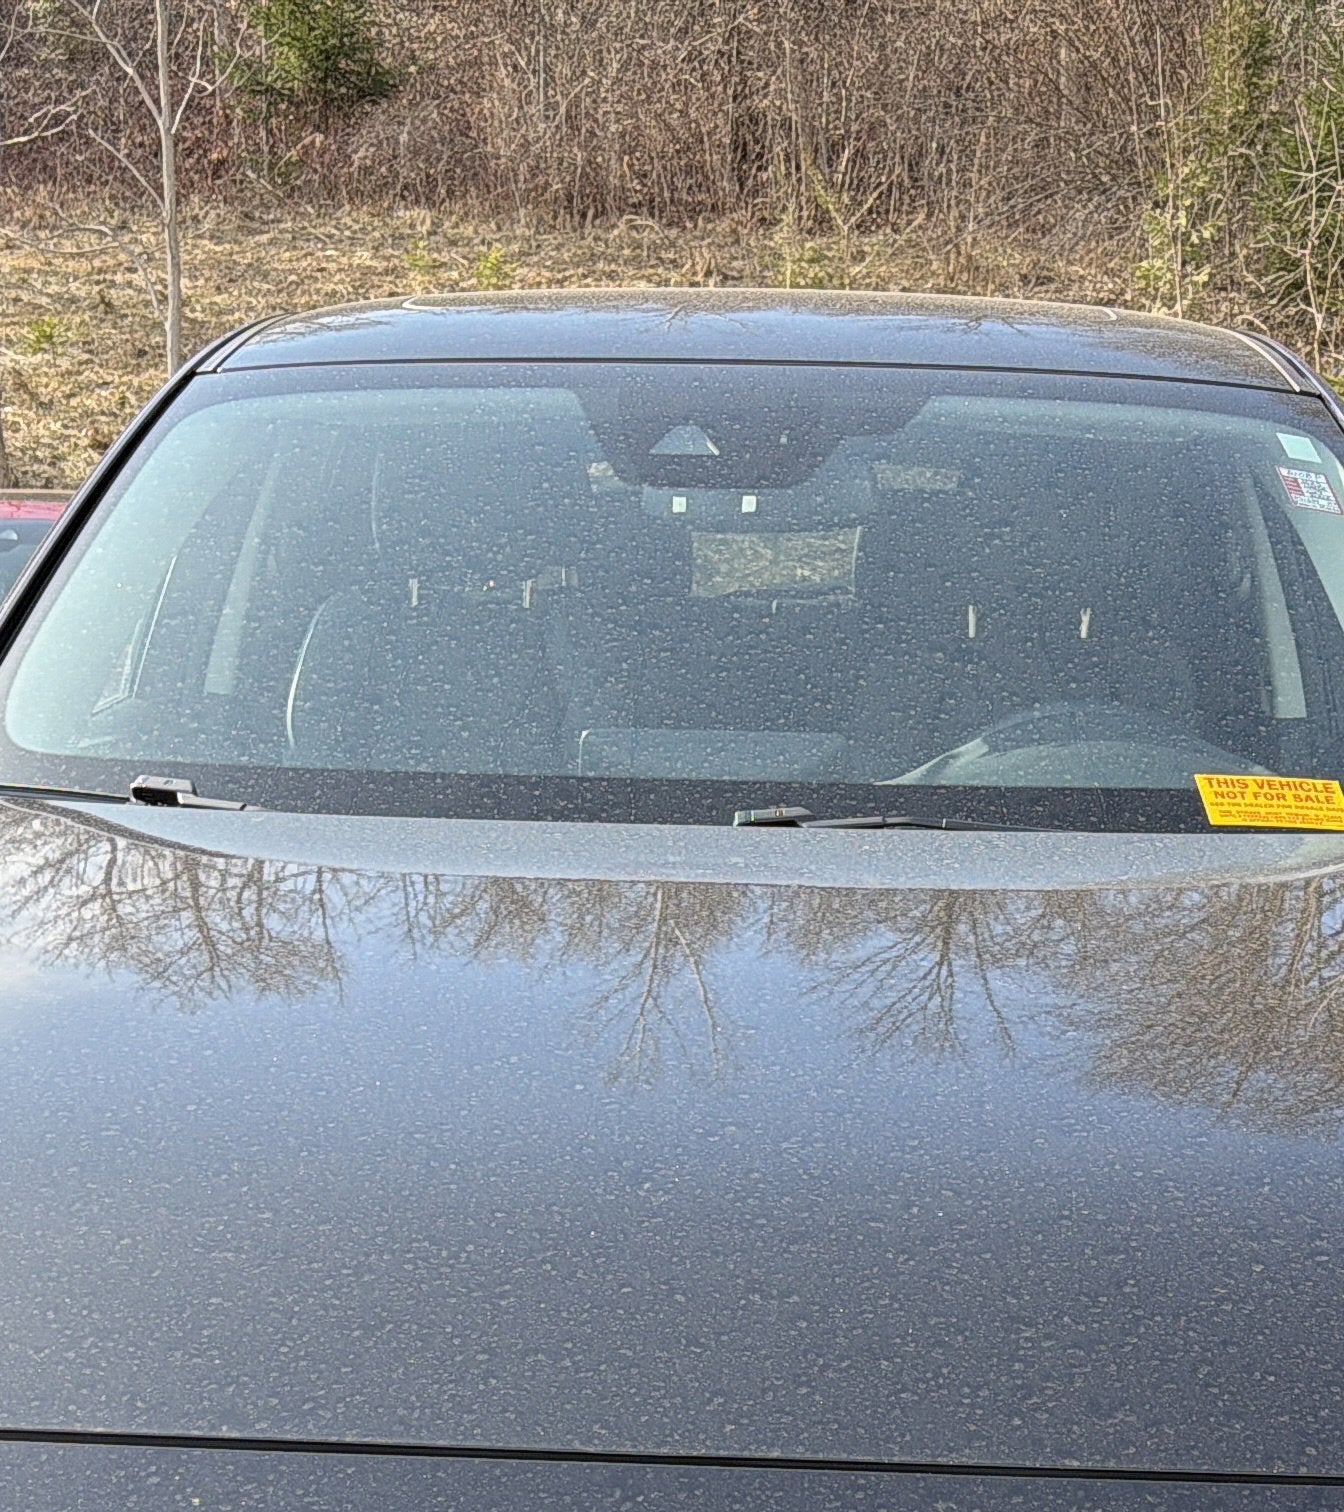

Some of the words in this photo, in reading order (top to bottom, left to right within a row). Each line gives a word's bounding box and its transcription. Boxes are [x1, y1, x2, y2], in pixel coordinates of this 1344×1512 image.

[1204, 777, 1249, 789] THIS
[1252, 778, 1336, 794] VEHICLE
[1213, 790, 1246, 800] NOT
[1252, 791, 1287, 802] FOR
[1292, 793, 1336, 804] SALE
